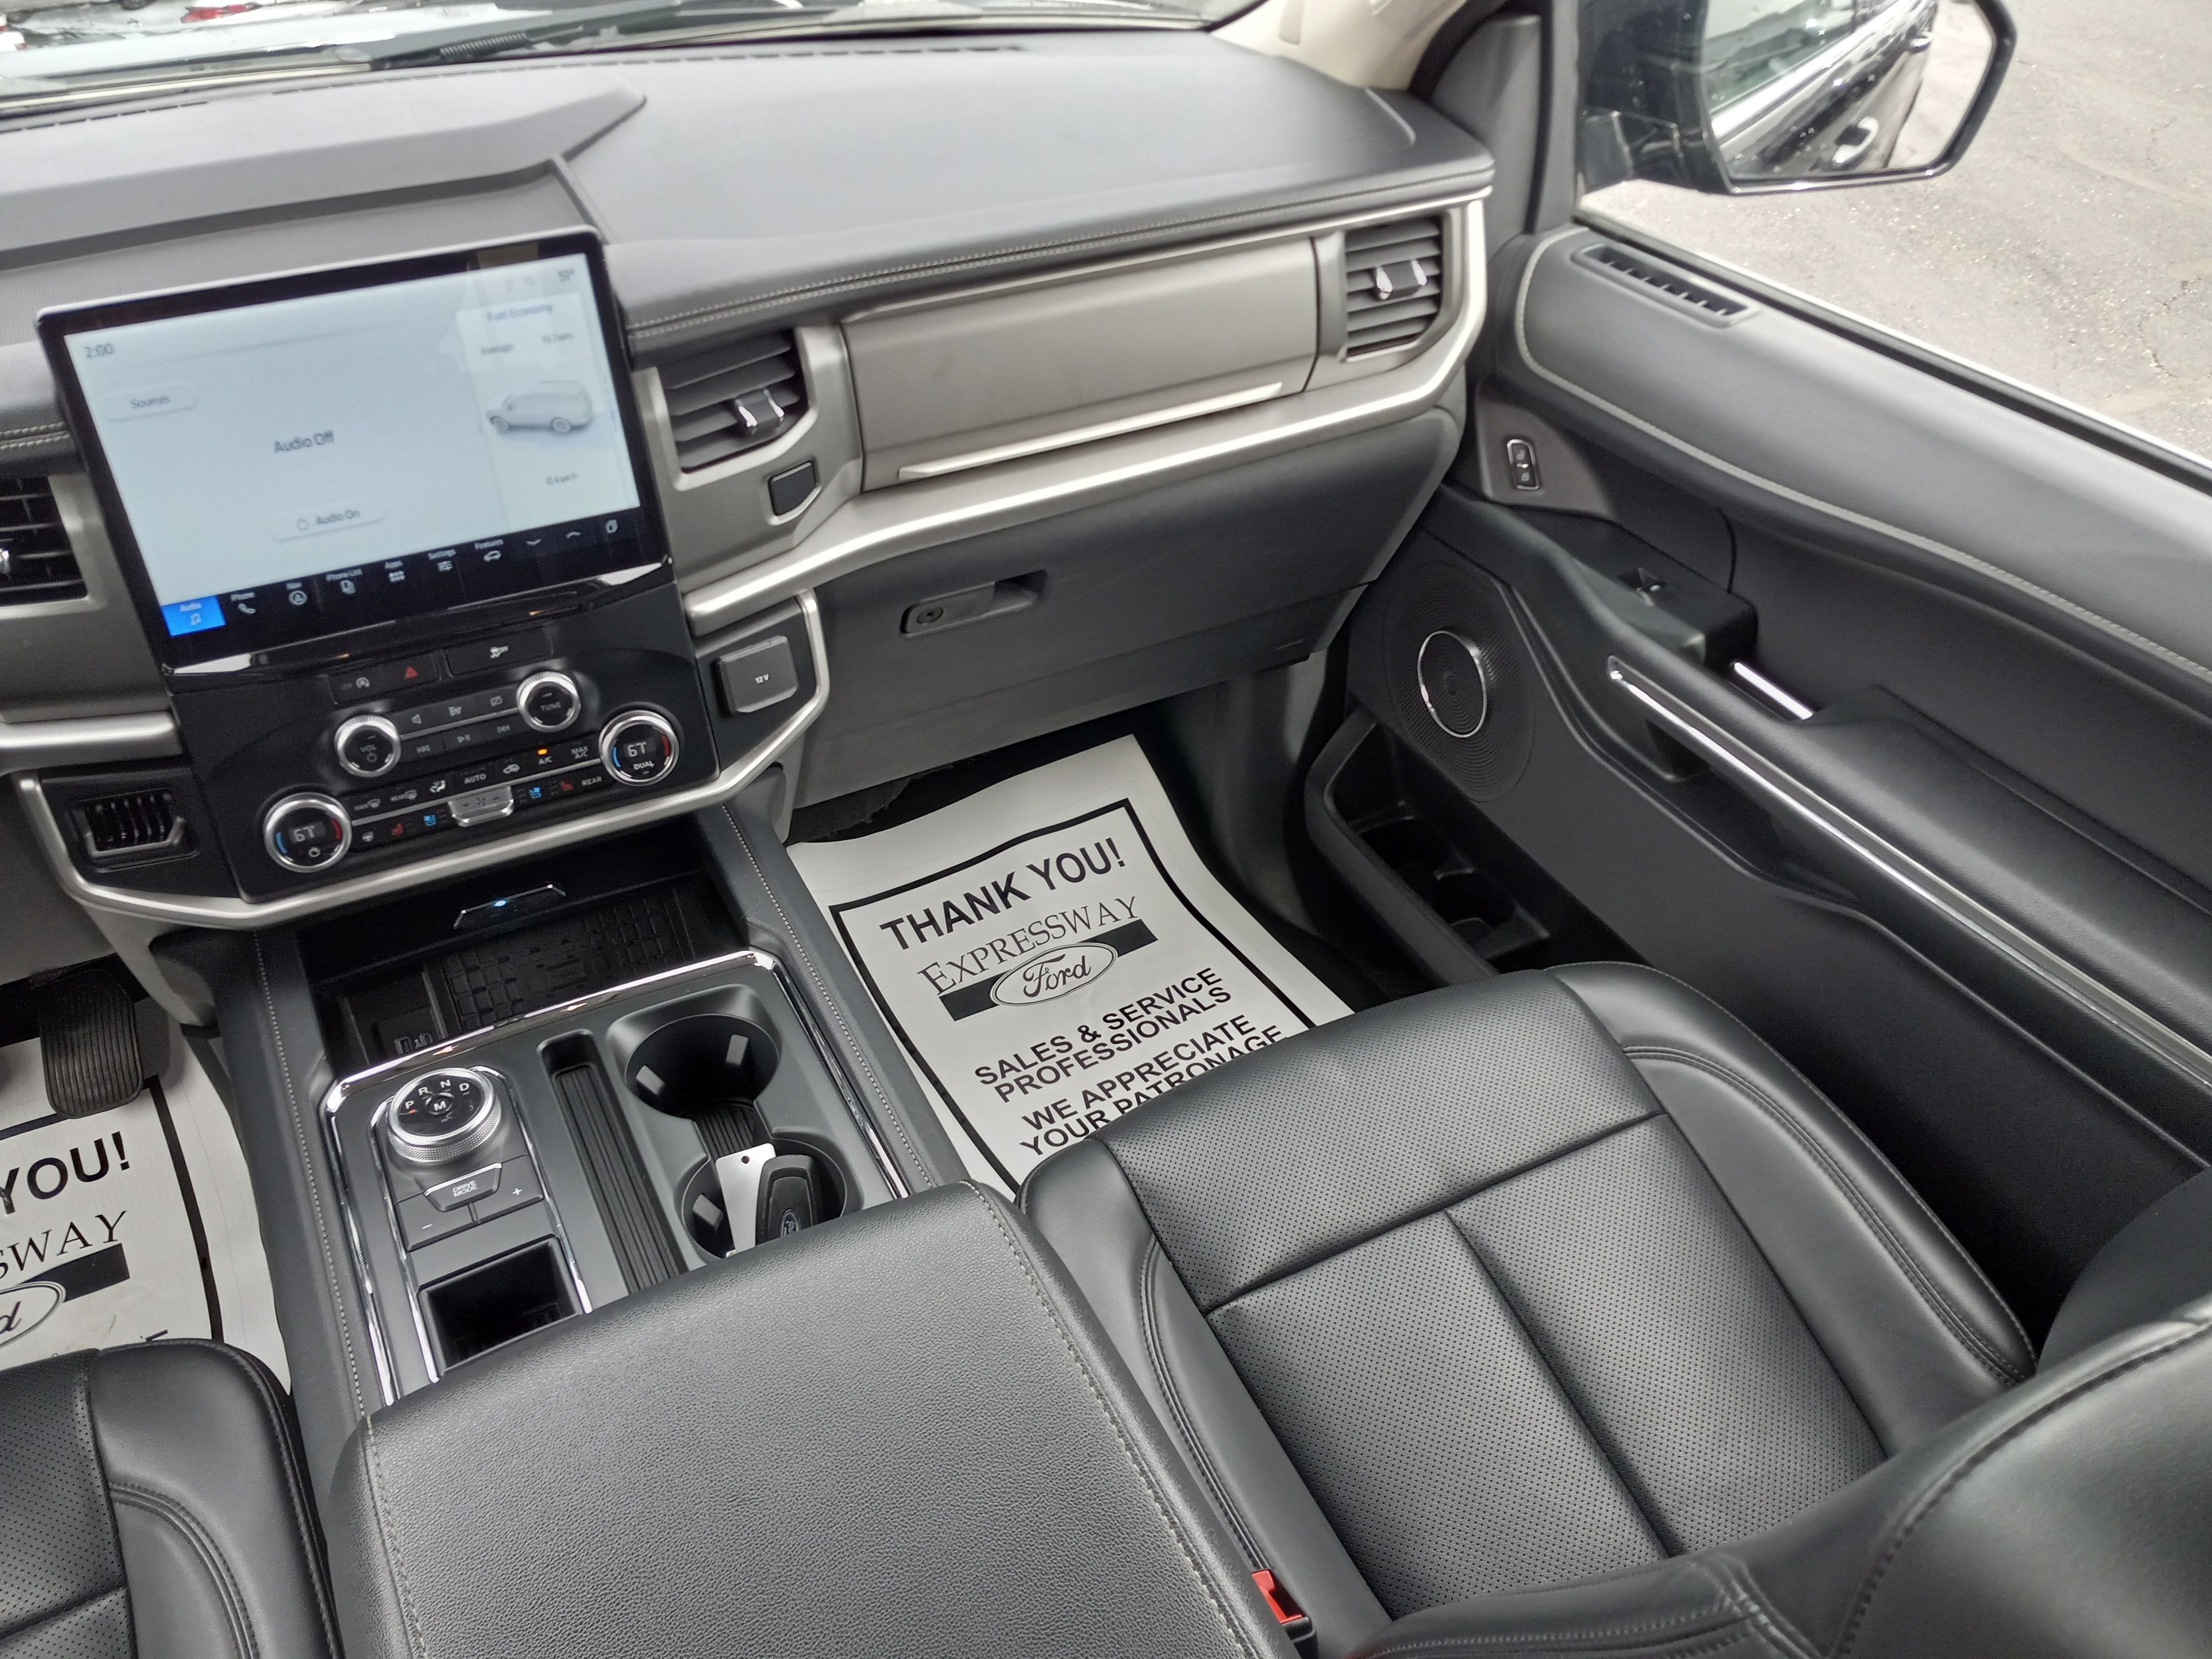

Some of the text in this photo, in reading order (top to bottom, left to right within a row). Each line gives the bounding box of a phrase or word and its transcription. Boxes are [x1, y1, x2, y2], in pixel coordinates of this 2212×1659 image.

[274, 431, 335, 453] Audio Off
[316, 509, 361, 525] Audio On
[540, 701, 562, 711] TUNE
[571, 745, 589, 755] MAX
[538, 756, 553, 765] A/C
[633, 760, 655, 770] DUAL
[464, 773, 487, 784] AUTO
[581, 776, 603, 787] REAR
[879, 838, 1126, 950] THANK YOU!
[917, 896, 1138, 996] EXPRESSWAY
[1022, 953, 1092, 998] Ford
[975, 967, 1223, 1085] SALES & SERVICE
[995, 986, 1232, 1103] PROFESSIONALS
[1021, 1014, 1257, 1130] WE APPRECIATE
[418, 1086, 429, 1096] R
[440, 1079, 451, 1089] N
[459, 1082, 470, 1092] D
[405, 1100, 415, 1109] P
[433, 1100, 447, 1111] M
[1019, 1110, 1111, 1155] YOUR
[0, 1131, 130, 1215] YOU!
[452, 1179, 476, 1193] DRIVE
[453, 1184, 478, 1198] MODE
